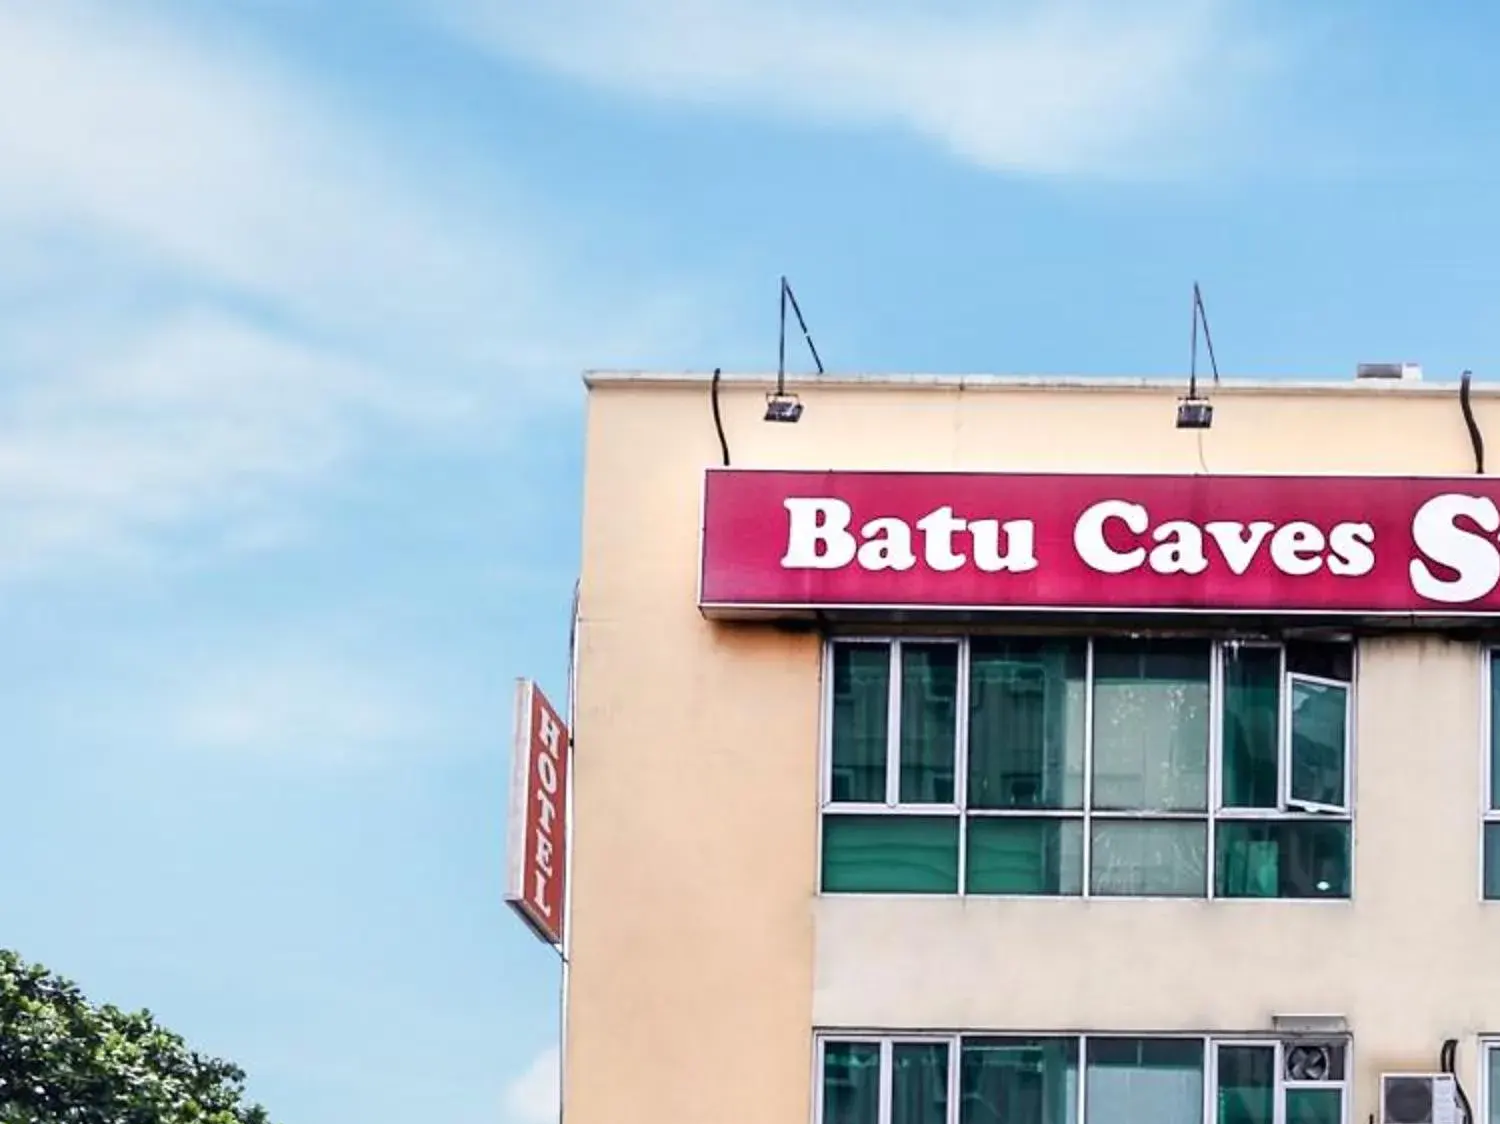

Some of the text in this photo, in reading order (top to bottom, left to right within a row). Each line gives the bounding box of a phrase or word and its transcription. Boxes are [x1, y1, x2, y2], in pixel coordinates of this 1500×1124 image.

[781, 497, 1037, 573] Batu
[1073, 500, 1375, 576] Caves
[534, 706, 560, 917] HOTEL
